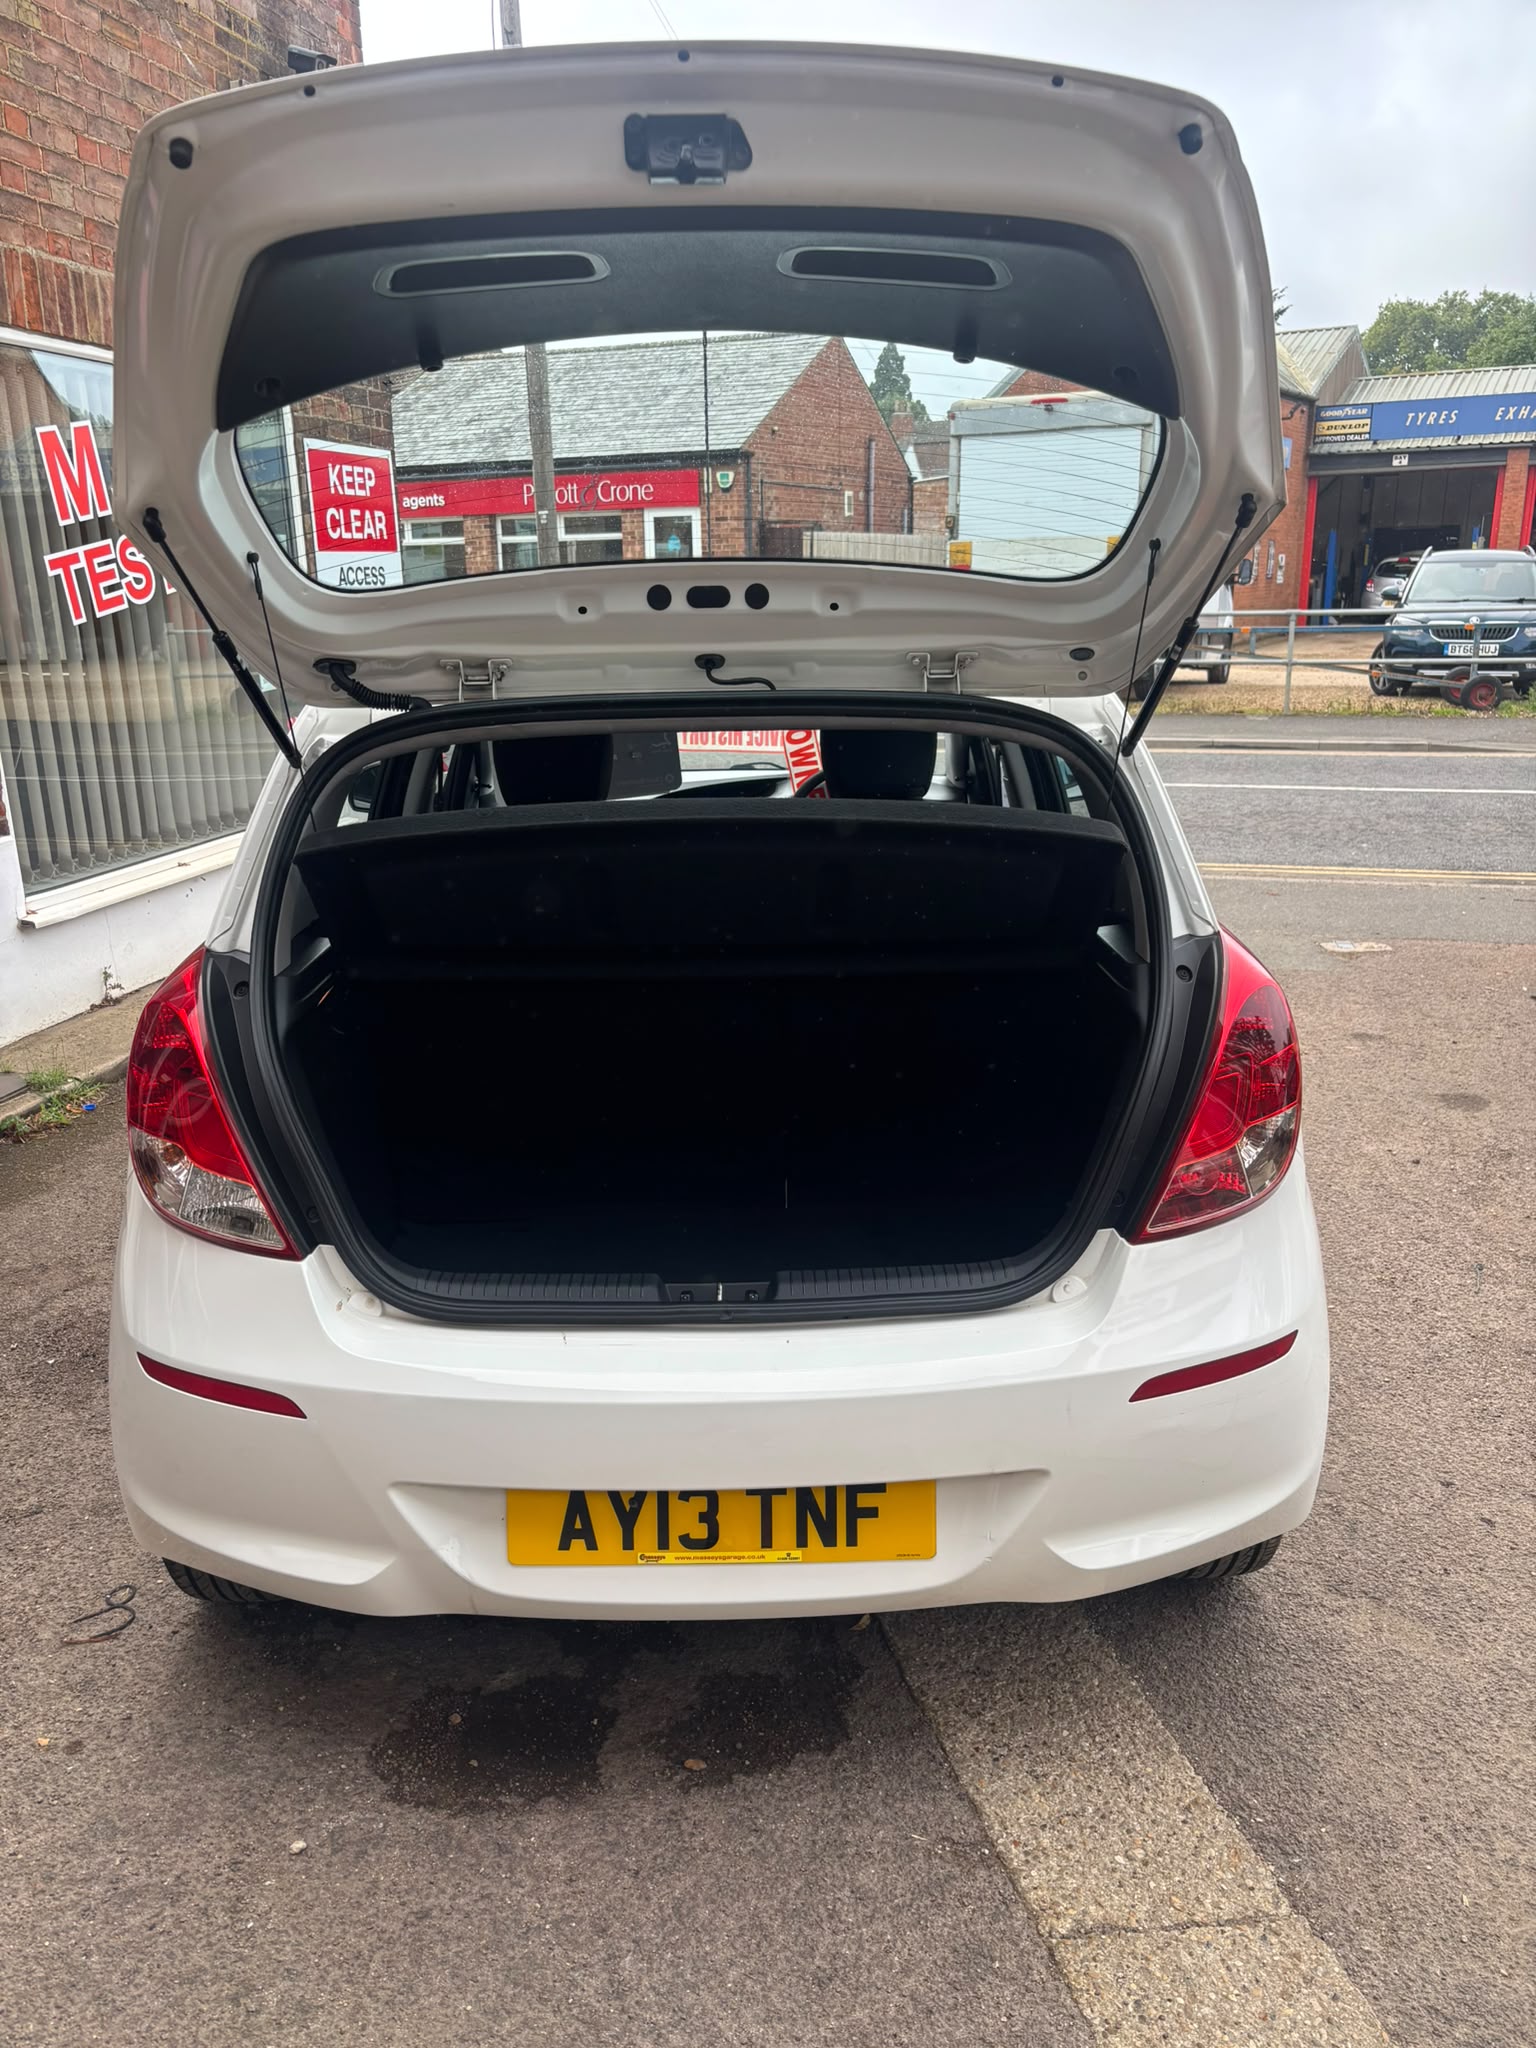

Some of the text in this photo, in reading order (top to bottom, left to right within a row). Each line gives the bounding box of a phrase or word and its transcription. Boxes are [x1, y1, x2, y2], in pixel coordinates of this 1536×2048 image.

[1320, 407, 1368, 418] GOODYEAR
[1405, 410, 1458, 427] TYRES
[1315, 433, 1370, 443] APPROVED DEALER
[1326, 423, 1369, 432] DUNLOP
[35, 420, 114, 526] M
[328, 463, 376, 497] KEEP
[402, 493, 446, 510] agents
[523, 482, 580, 506] Pott
[597, 479, 654, 503] Crone
[326, 507, 388, 540] CLEAR
[43, 534, 177, 626] TES
[338, 566, 387, 587] ACCESS
[558, 1483, 887, 1551] AY13 TNF
